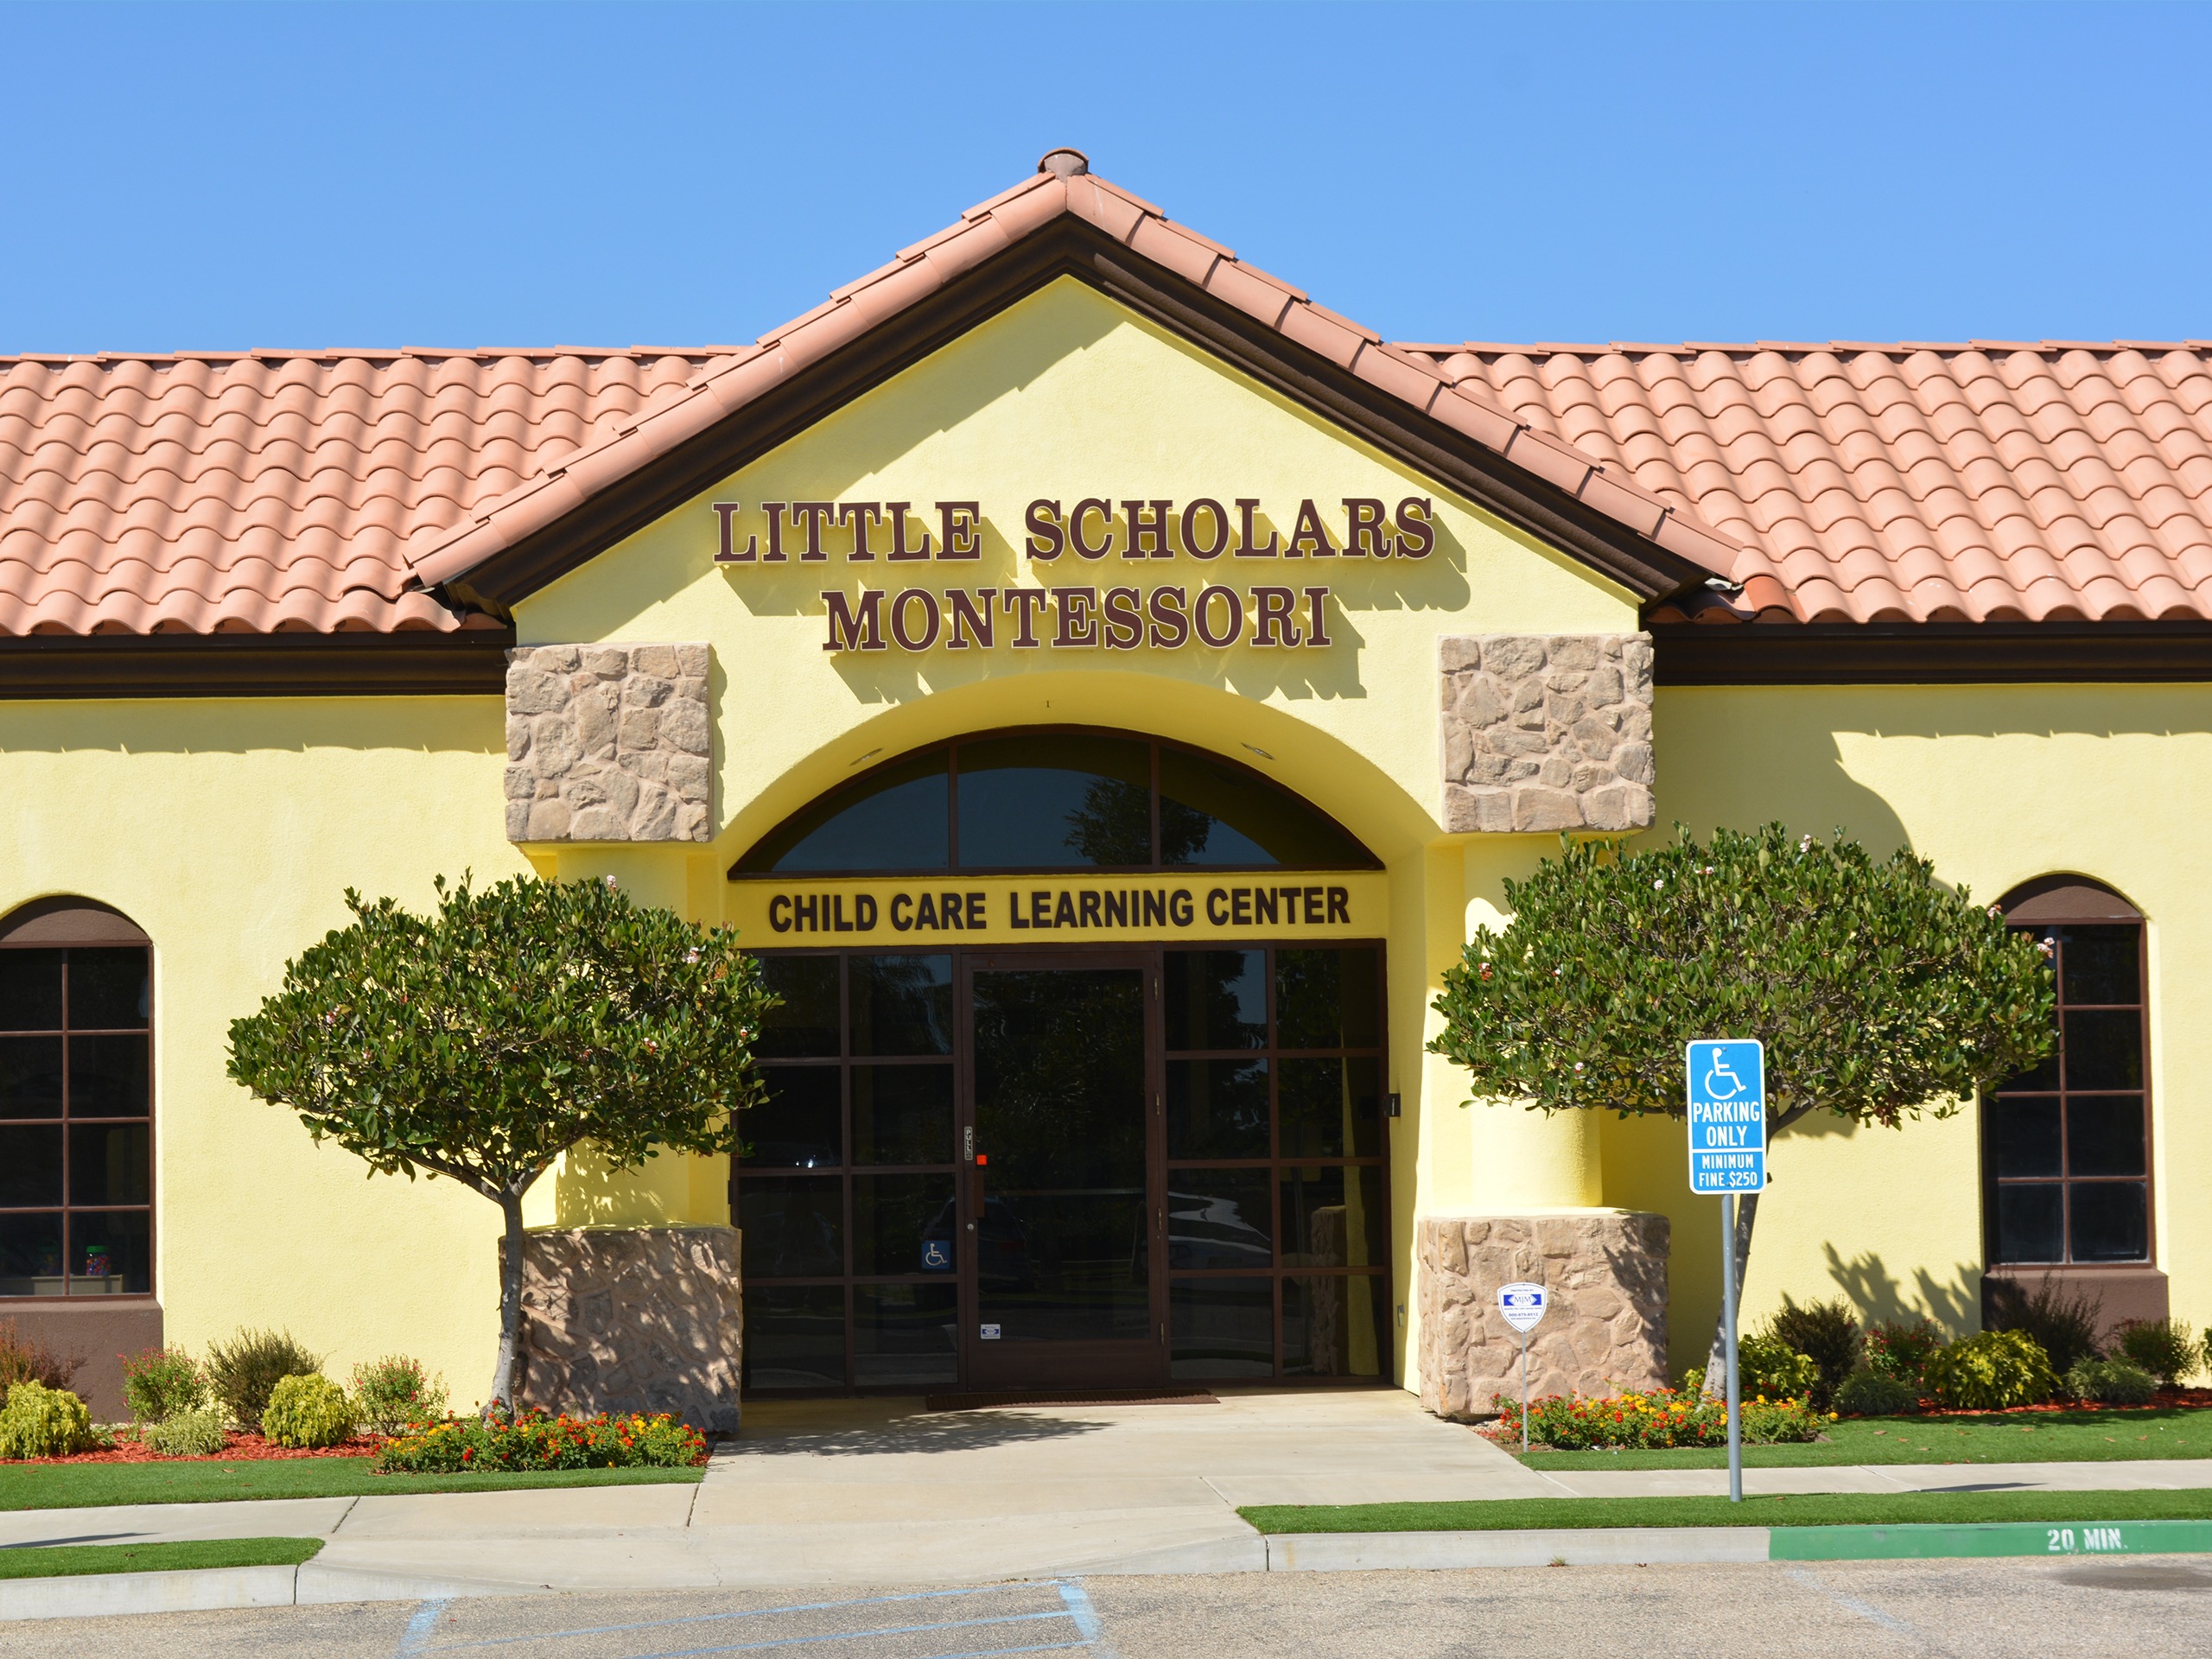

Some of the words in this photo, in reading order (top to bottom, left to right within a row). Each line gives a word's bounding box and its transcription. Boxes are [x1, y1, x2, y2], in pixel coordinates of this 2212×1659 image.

[713, 501, 981, 563] LITTLE
[1025, 497, 1434, 561] SCHOLARS
[821, 585, 1332, 651] MONTESSORI
[769, 894, 878, 932] CHILD
[890, 892, 987, 931] CARE
[1009, 889, 1194, 929] LEARNING
[1206, 887, 1351, 926] CENTER
[1693, 1101, 1760, 1123] PARKING
[1706, 1125, 1748, 1147] ONLY
[1701, 1154, 1754, 1169] MINIMUM
[1699, 1172, 1726, 1187] FINE
[1728, 1171, 1758, 1188] $250
[2047, 1529, 2075, 1551] 20
